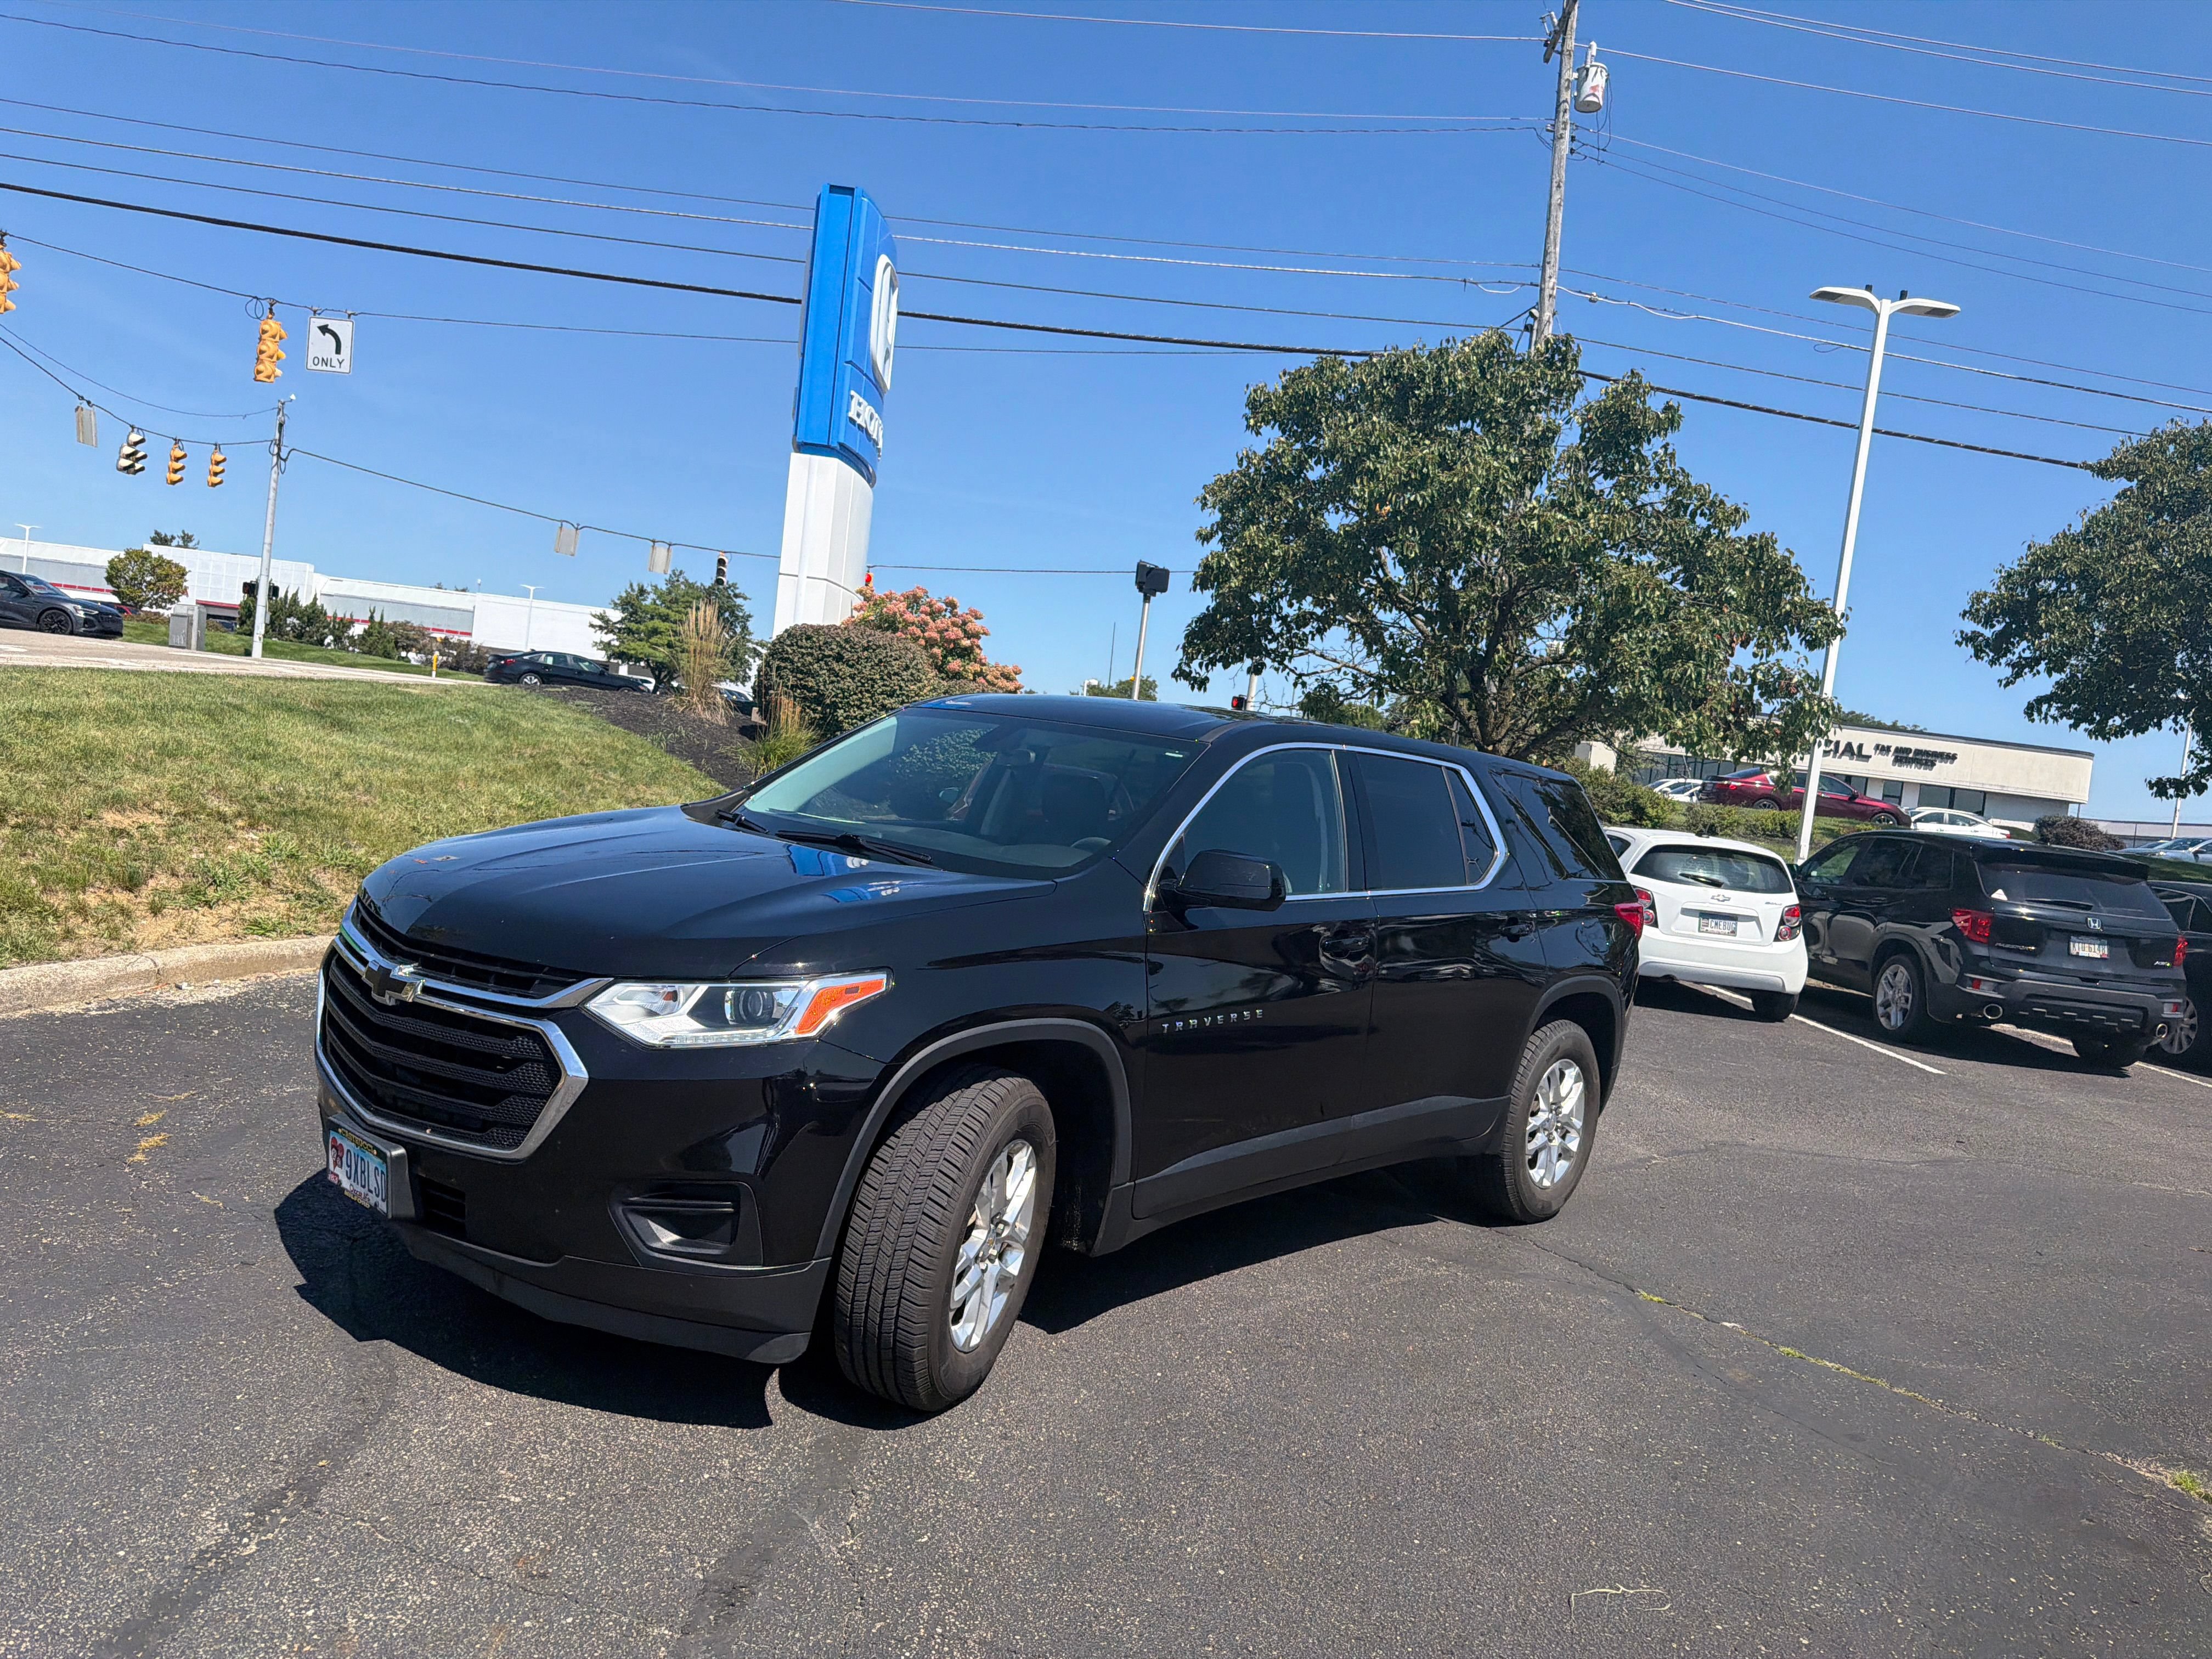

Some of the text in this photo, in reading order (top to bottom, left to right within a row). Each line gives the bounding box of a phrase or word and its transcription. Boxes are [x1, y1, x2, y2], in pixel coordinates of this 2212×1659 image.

[312, 356, 345, 369] ONLY
[1161, 1008, 1263, 1034] TRAVERSE
[346, 1149, 387, 1203] 9XBLSD
